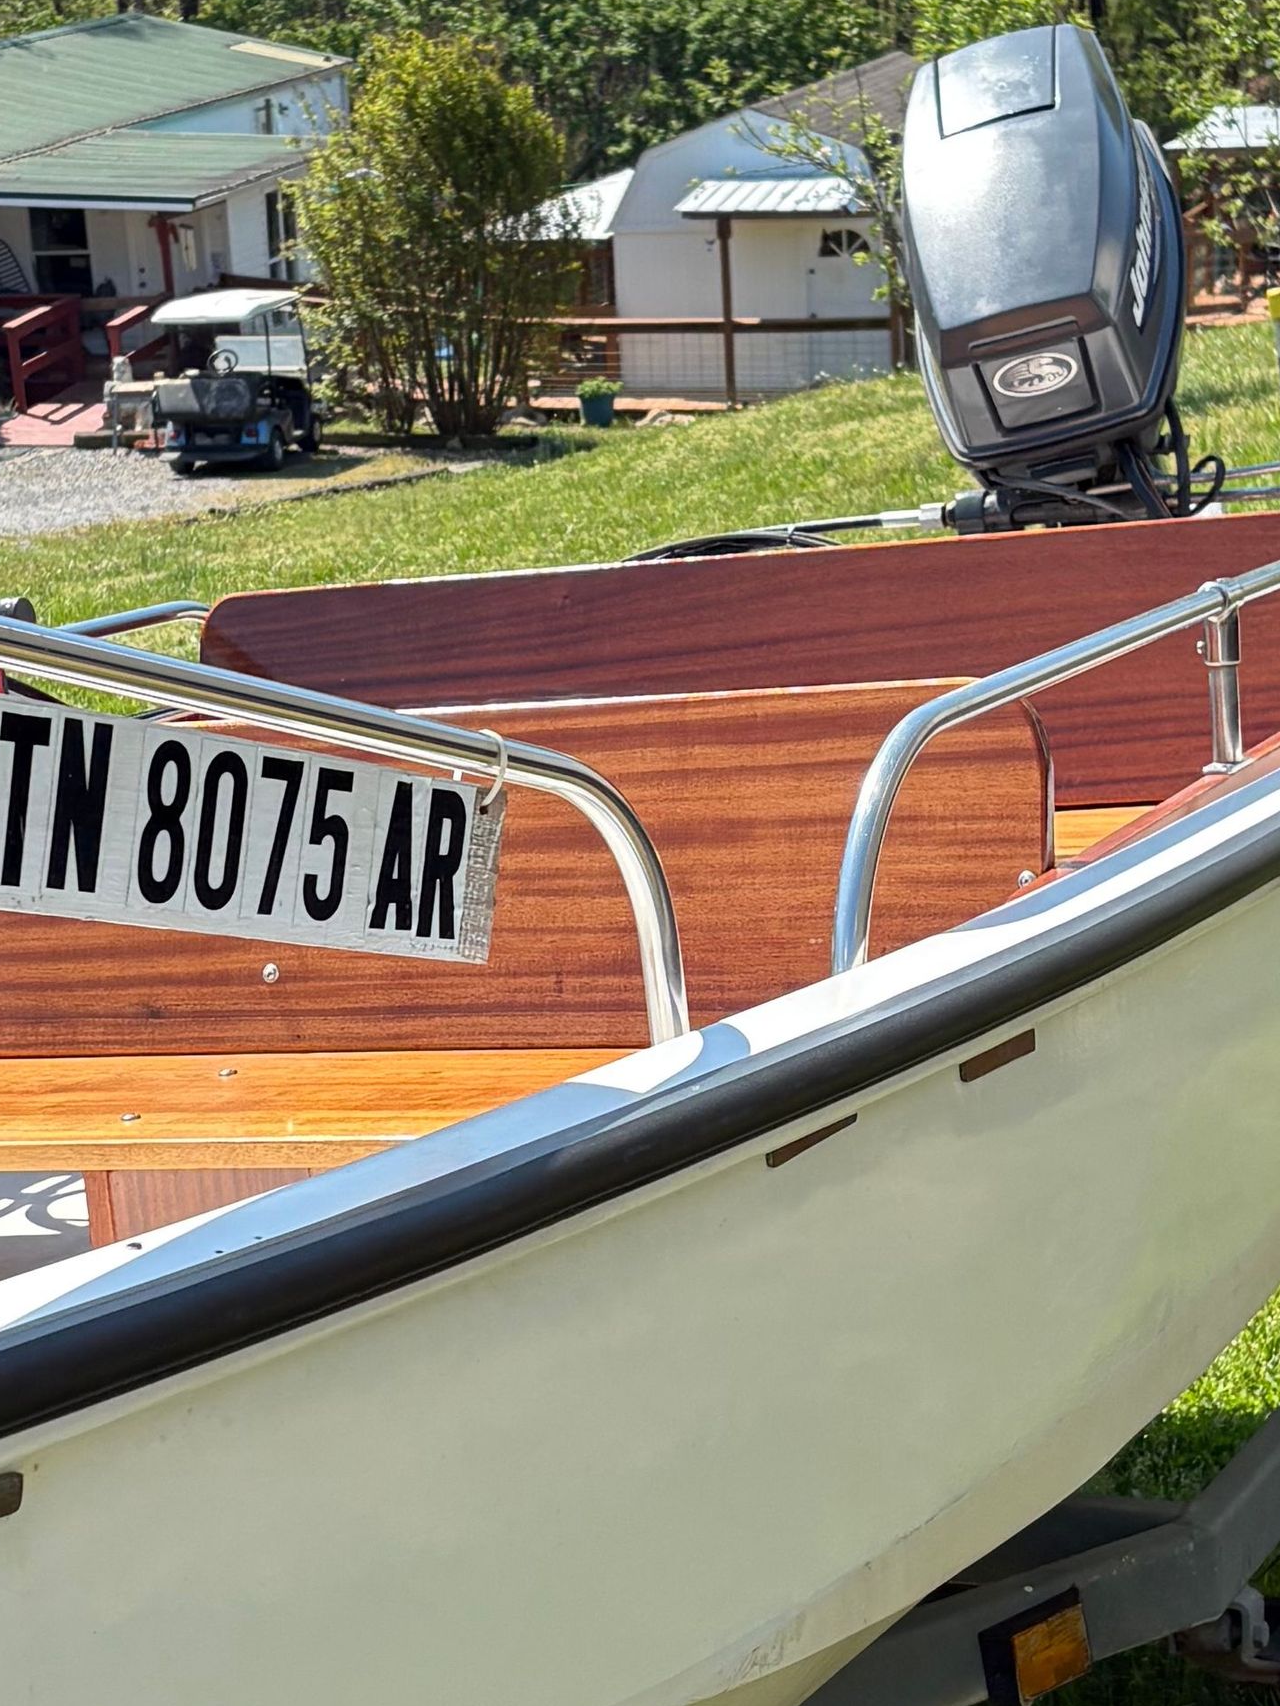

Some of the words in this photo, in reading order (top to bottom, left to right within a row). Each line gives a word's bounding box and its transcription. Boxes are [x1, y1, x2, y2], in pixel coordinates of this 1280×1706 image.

[0, 711, 114, 893] TN
[137, 740, 355, 922] 8075
[369, 781, 467, 940] AR
